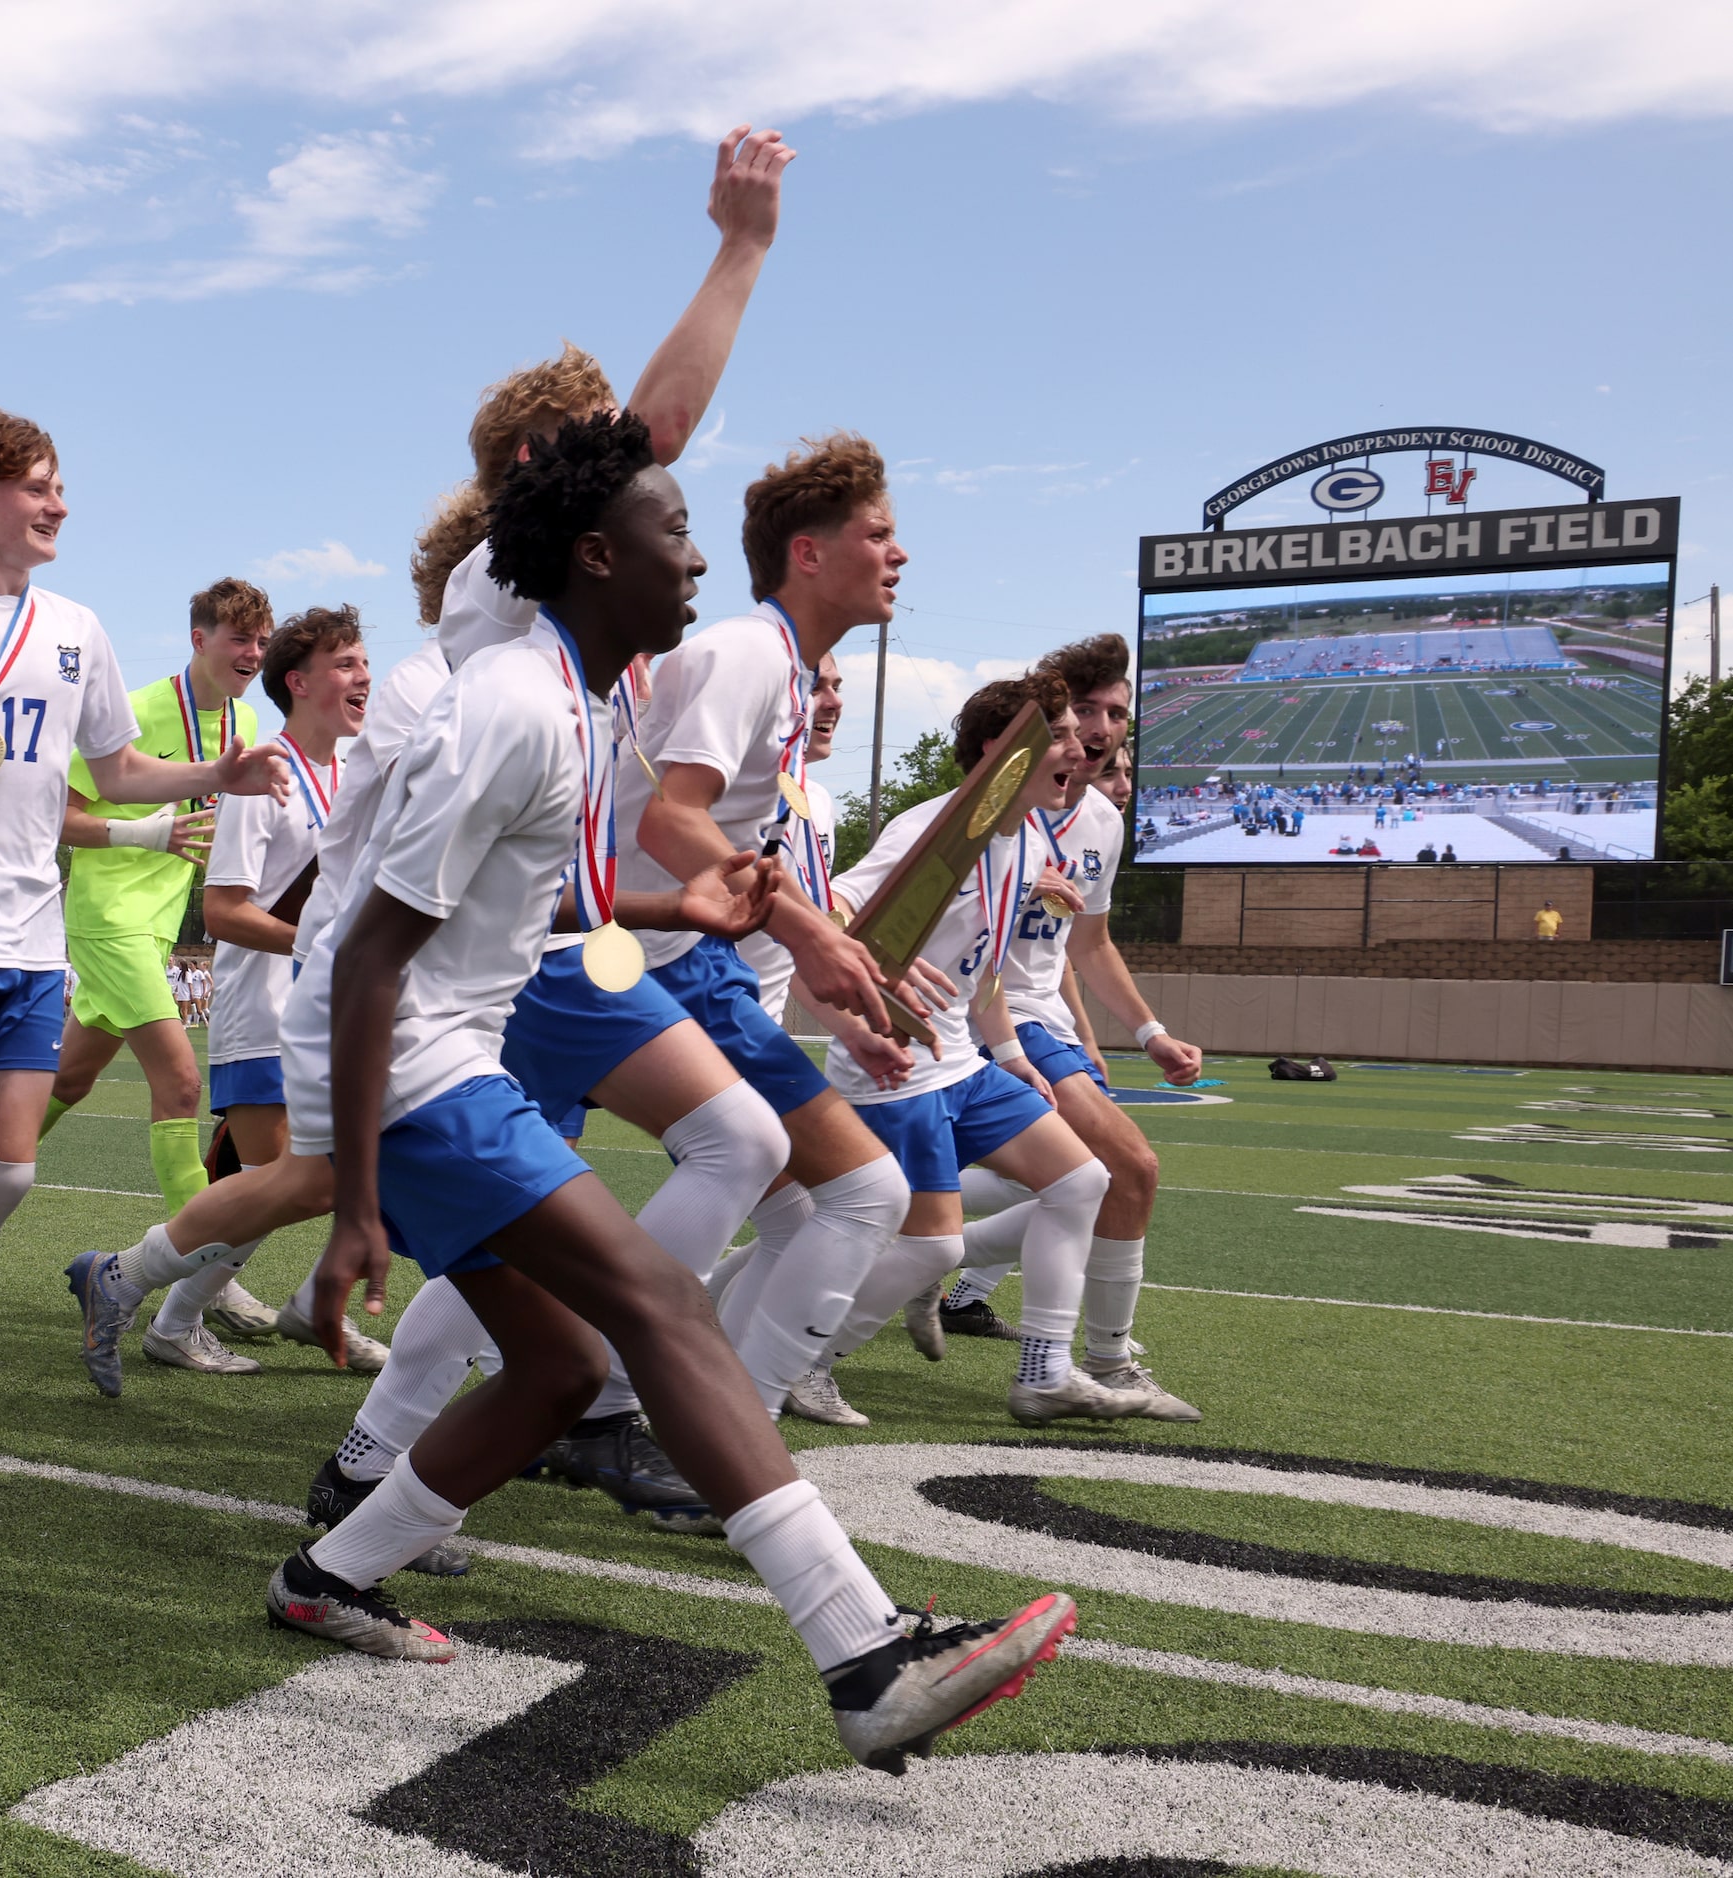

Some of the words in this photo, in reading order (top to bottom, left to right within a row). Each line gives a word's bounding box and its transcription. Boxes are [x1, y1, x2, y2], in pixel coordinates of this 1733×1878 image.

[1206, 451, 1320, 517] GEORGETOWN
[1322, 432, 1446, 461] INDEPENDENT
[1448, 431, 1521, 457] SCHOOL
[1523, 445, 1603, 488] DISTRICT
[1314, 470, 1382, 510] G
[1154, 520, 1481, 578] BIRKELBACH
[1497, 507, 1660, 555] FIELD
[2, 697, 47, 763] 17
[959, 927, 990, 976] 3
